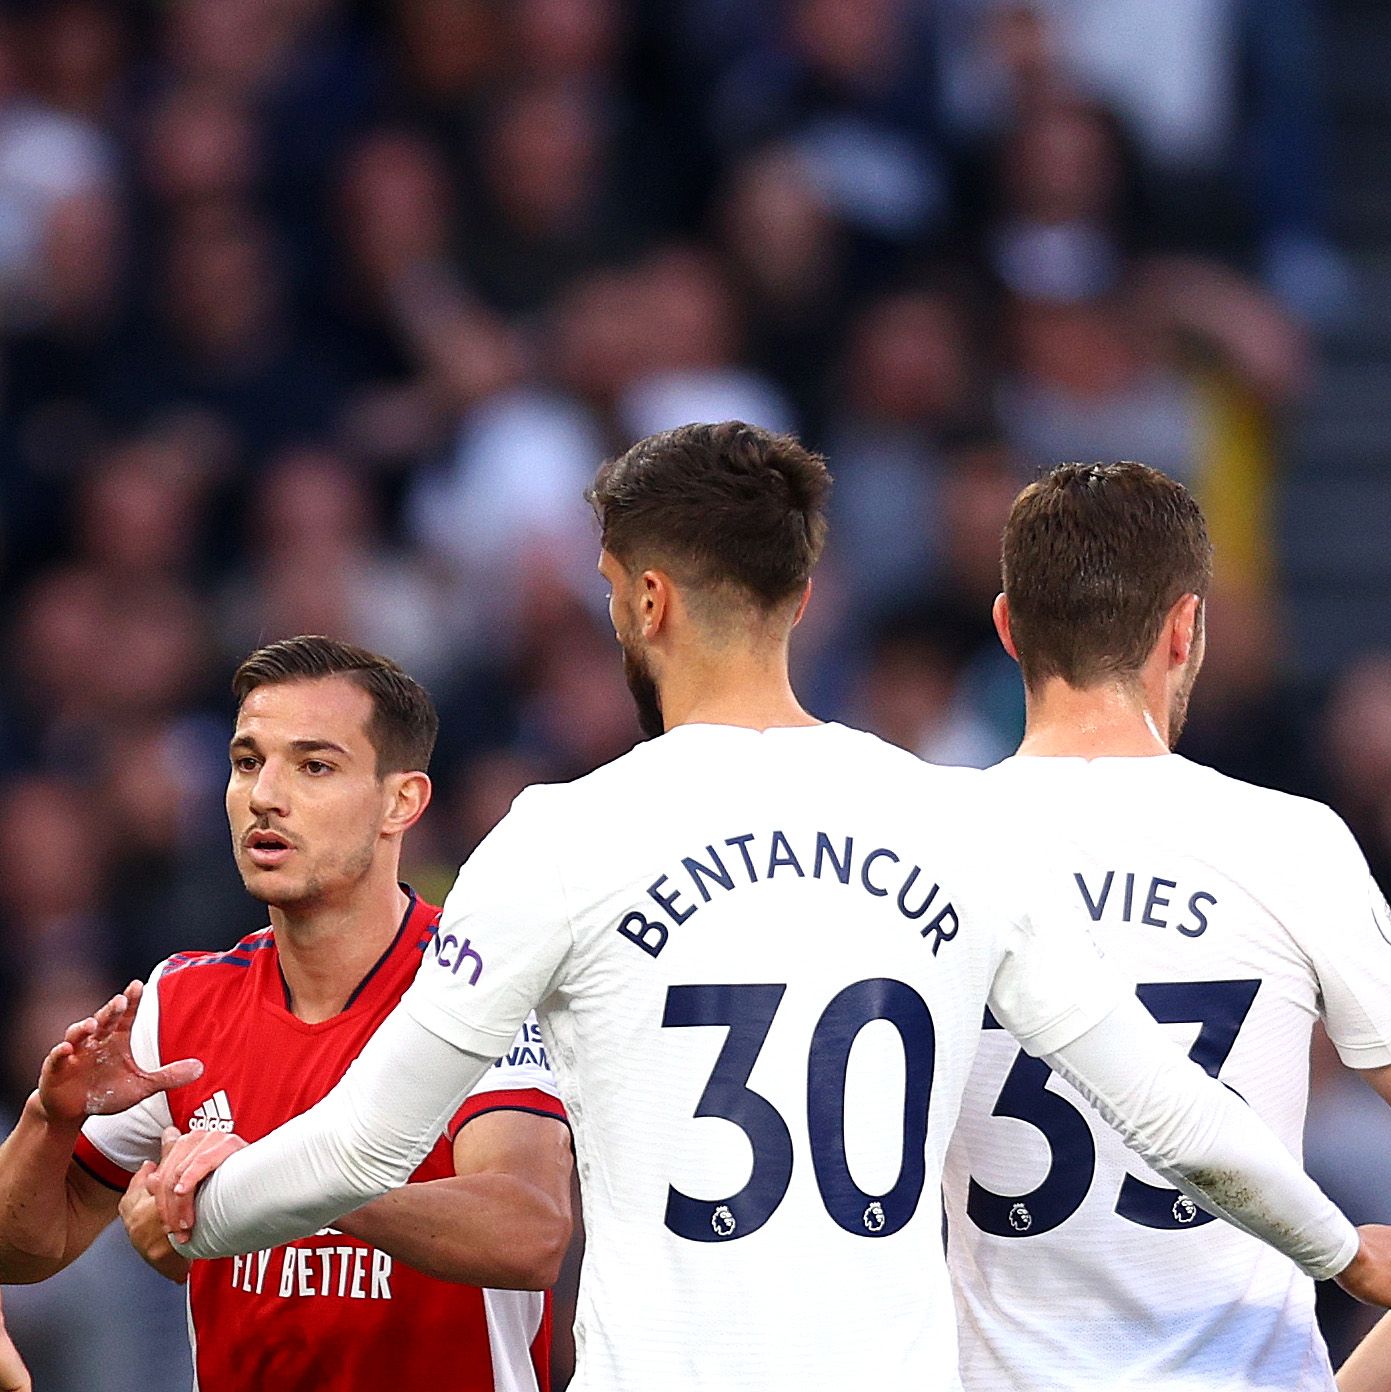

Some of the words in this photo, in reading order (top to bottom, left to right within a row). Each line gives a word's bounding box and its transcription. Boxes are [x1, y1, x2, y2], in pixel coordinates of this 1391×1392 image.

[616, 830, 960, 958] BENTANCUR
[1073, 871, 1218, 938] VIES
[189, 1114, 234, 1133] adidas
[661, 977, 936, 1243] 30
[232, 1248, 272, 1295] FLY
[278, 1246, 393, 1300] BETTER
